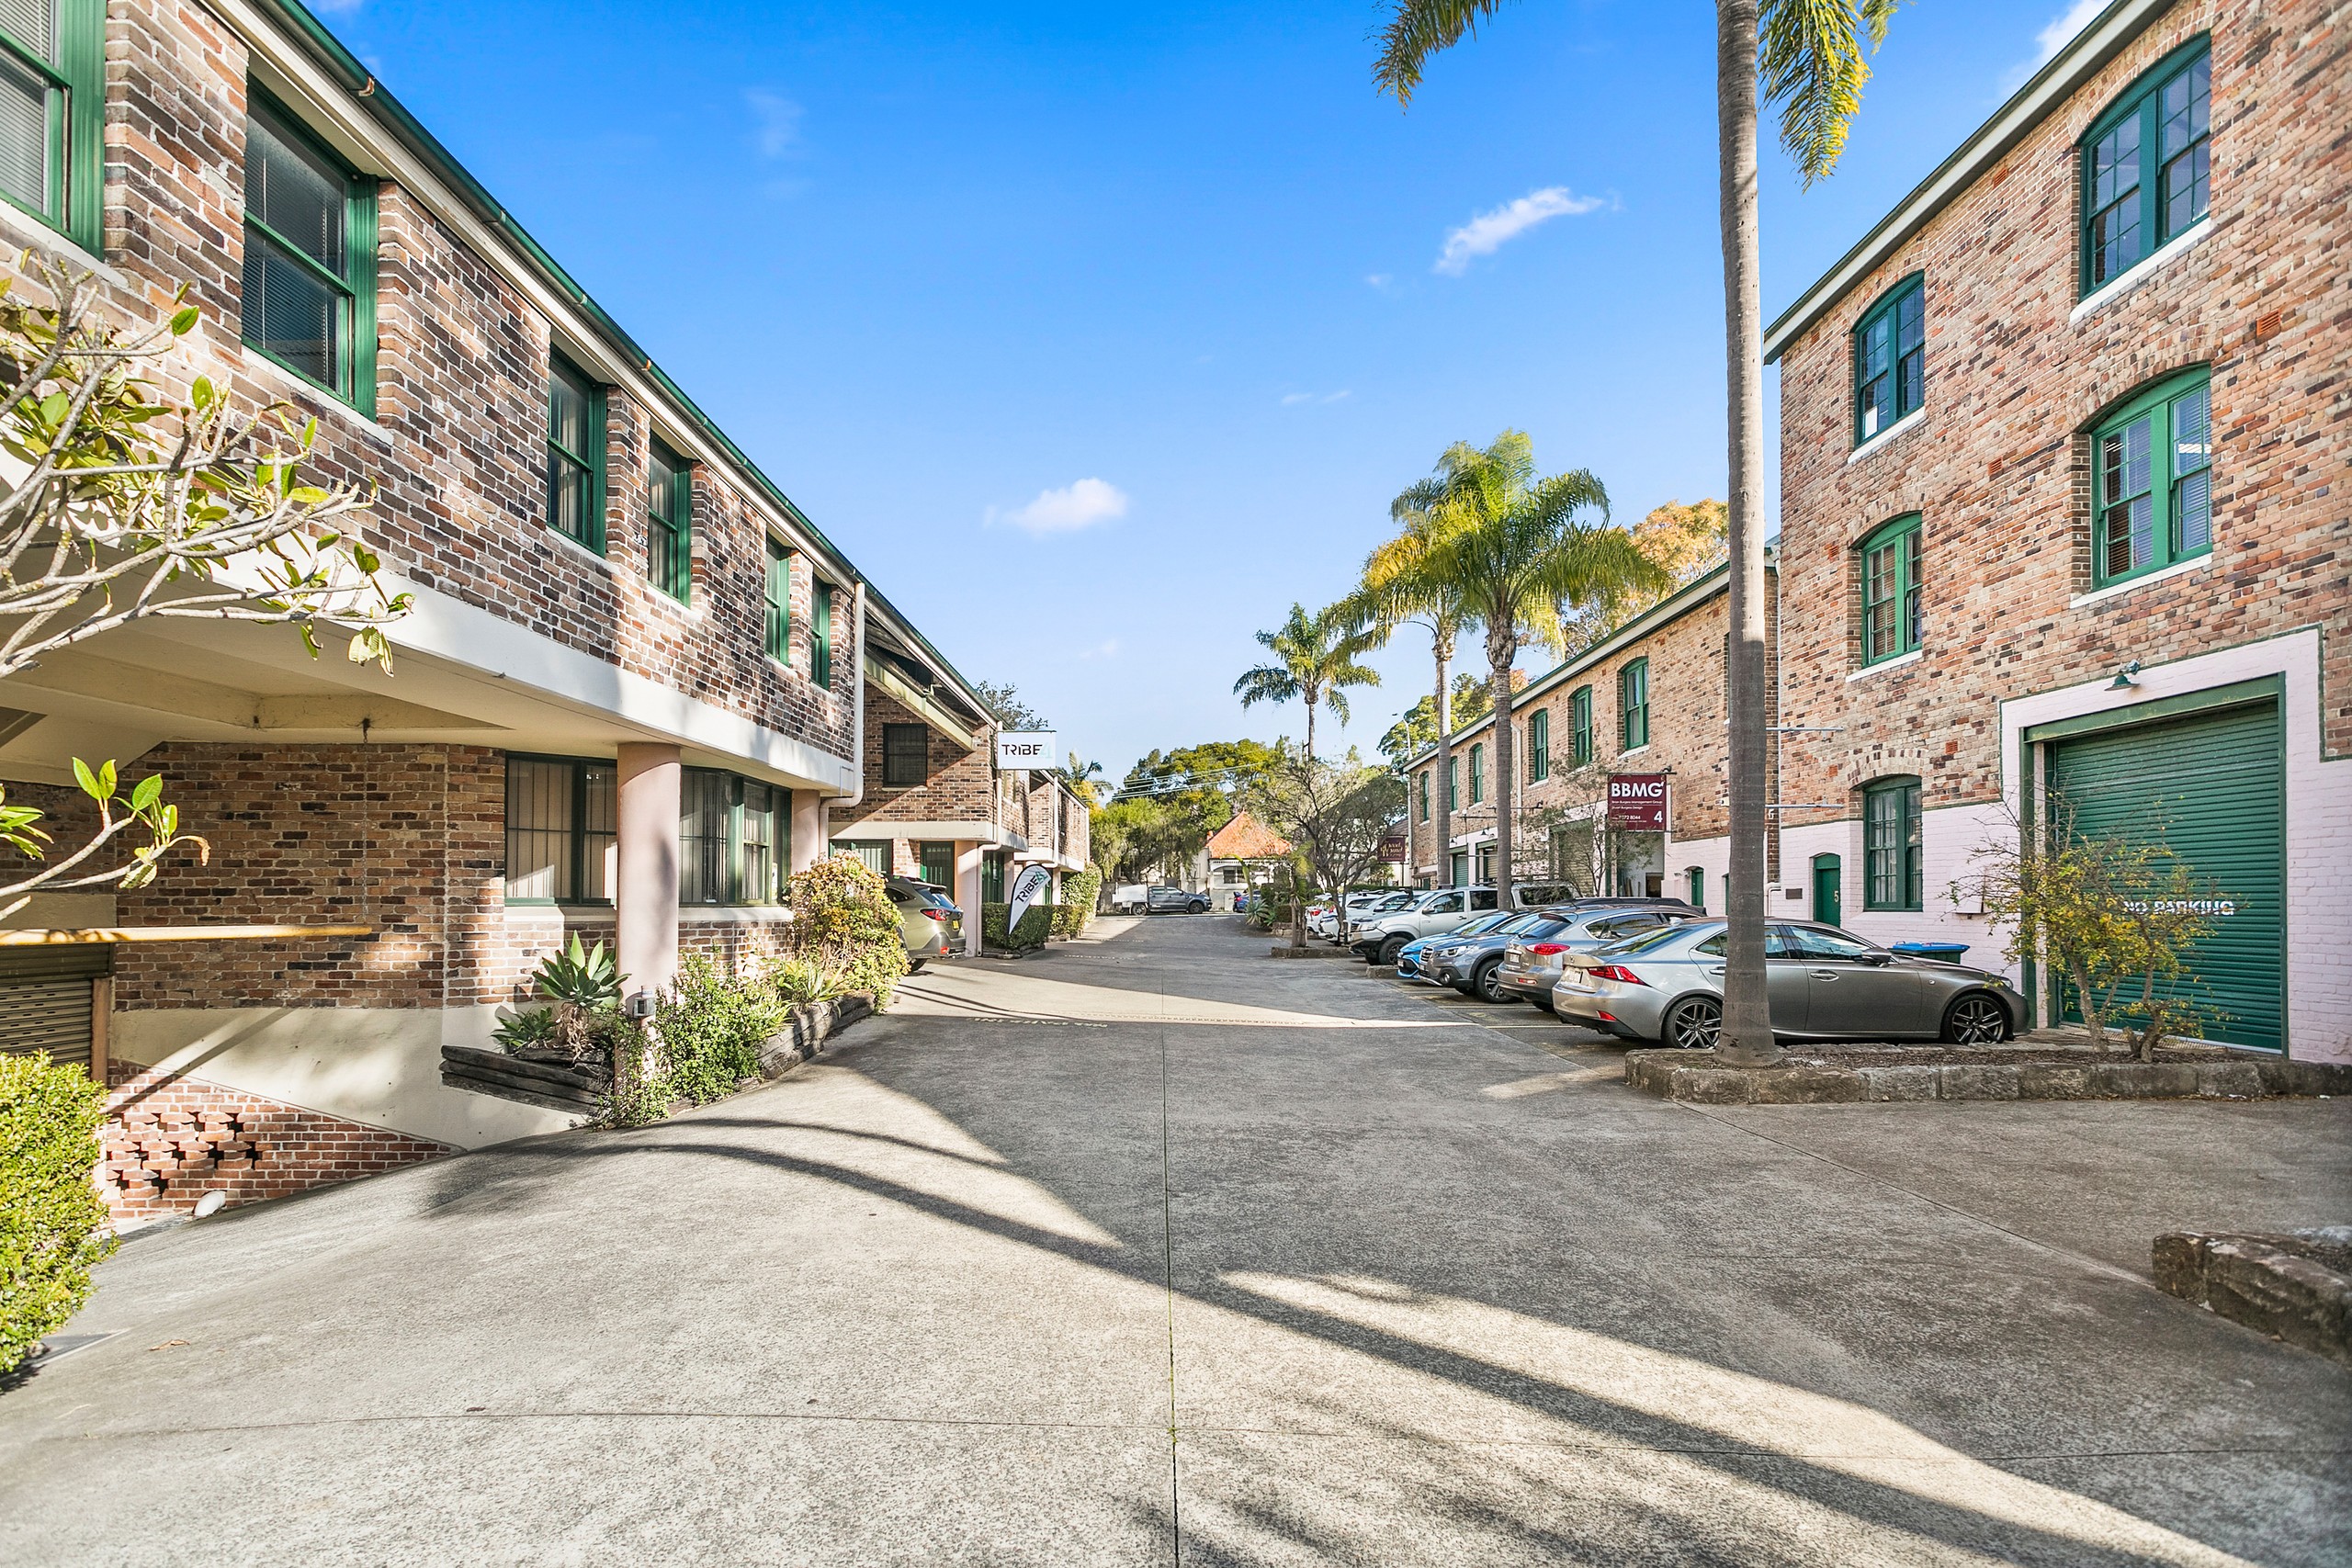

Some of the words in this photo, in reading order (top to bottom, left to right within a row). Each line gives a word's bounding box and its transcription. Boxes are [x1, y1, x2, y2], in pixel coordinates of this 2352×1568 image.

[1611, 782, 1664, 797] BBMG
[1654, 810, 1663, 823] 4
[1834, 890, 1839, 903] 5
[2154, 901, 2234, 915] PARKING
